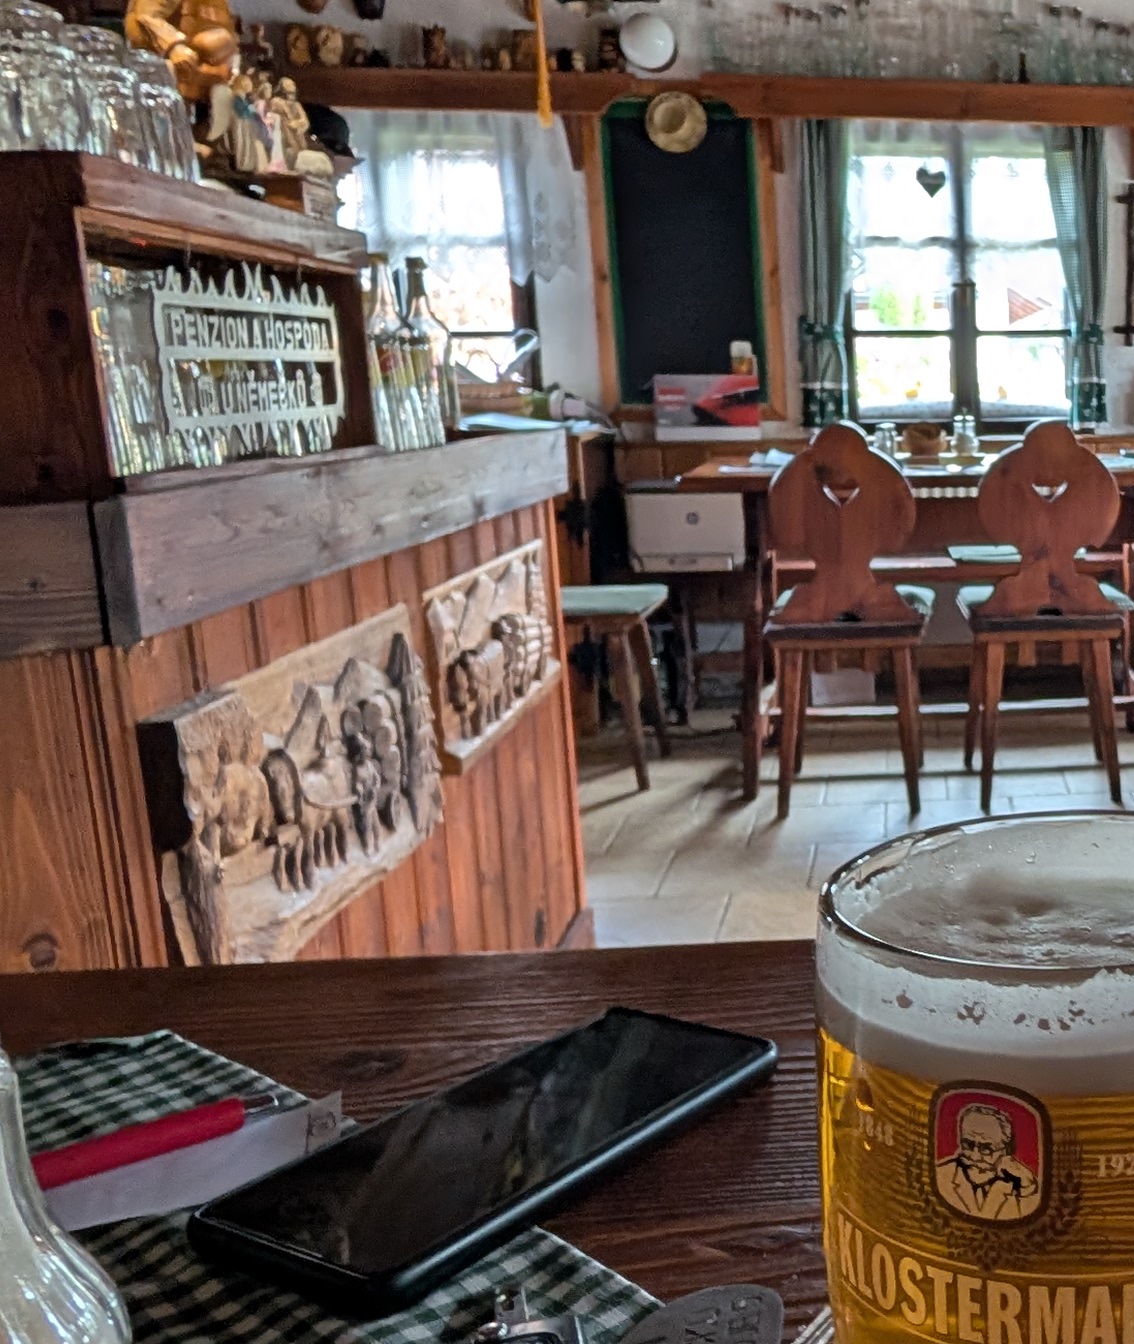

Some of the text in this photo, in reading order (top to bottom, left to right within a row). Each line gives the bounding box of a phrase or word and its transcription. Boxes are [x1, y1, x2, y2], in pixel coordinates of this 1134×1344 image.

[170, 311, 329, 350] PENZION A HOSPODA
